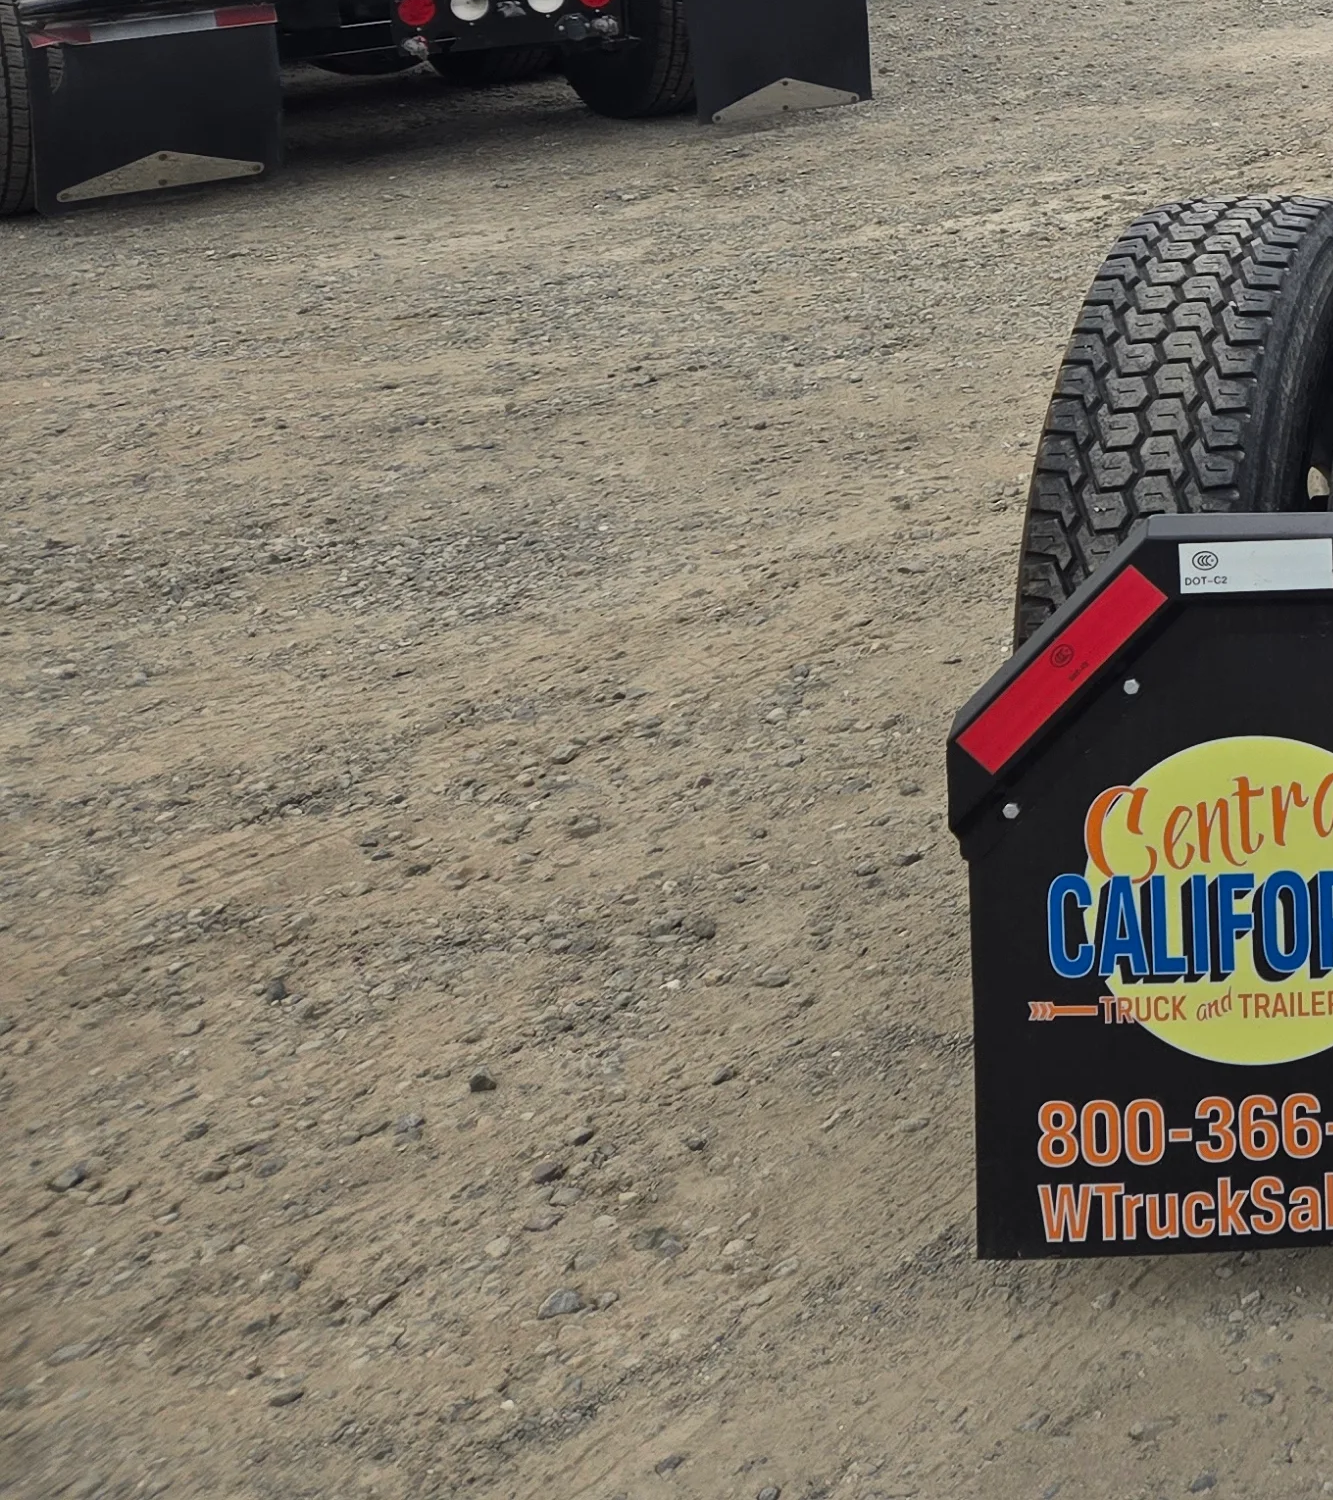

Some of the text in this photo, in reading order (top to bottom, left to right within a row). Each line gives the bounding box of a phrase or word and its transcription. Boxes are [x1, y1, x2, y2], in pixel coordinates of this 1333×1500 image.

[1184, 575, 1228, 586] DOT-C2
[1100, 995, 1187, 1024] TRUCK
[1195, 990, 1233, 1021] and
